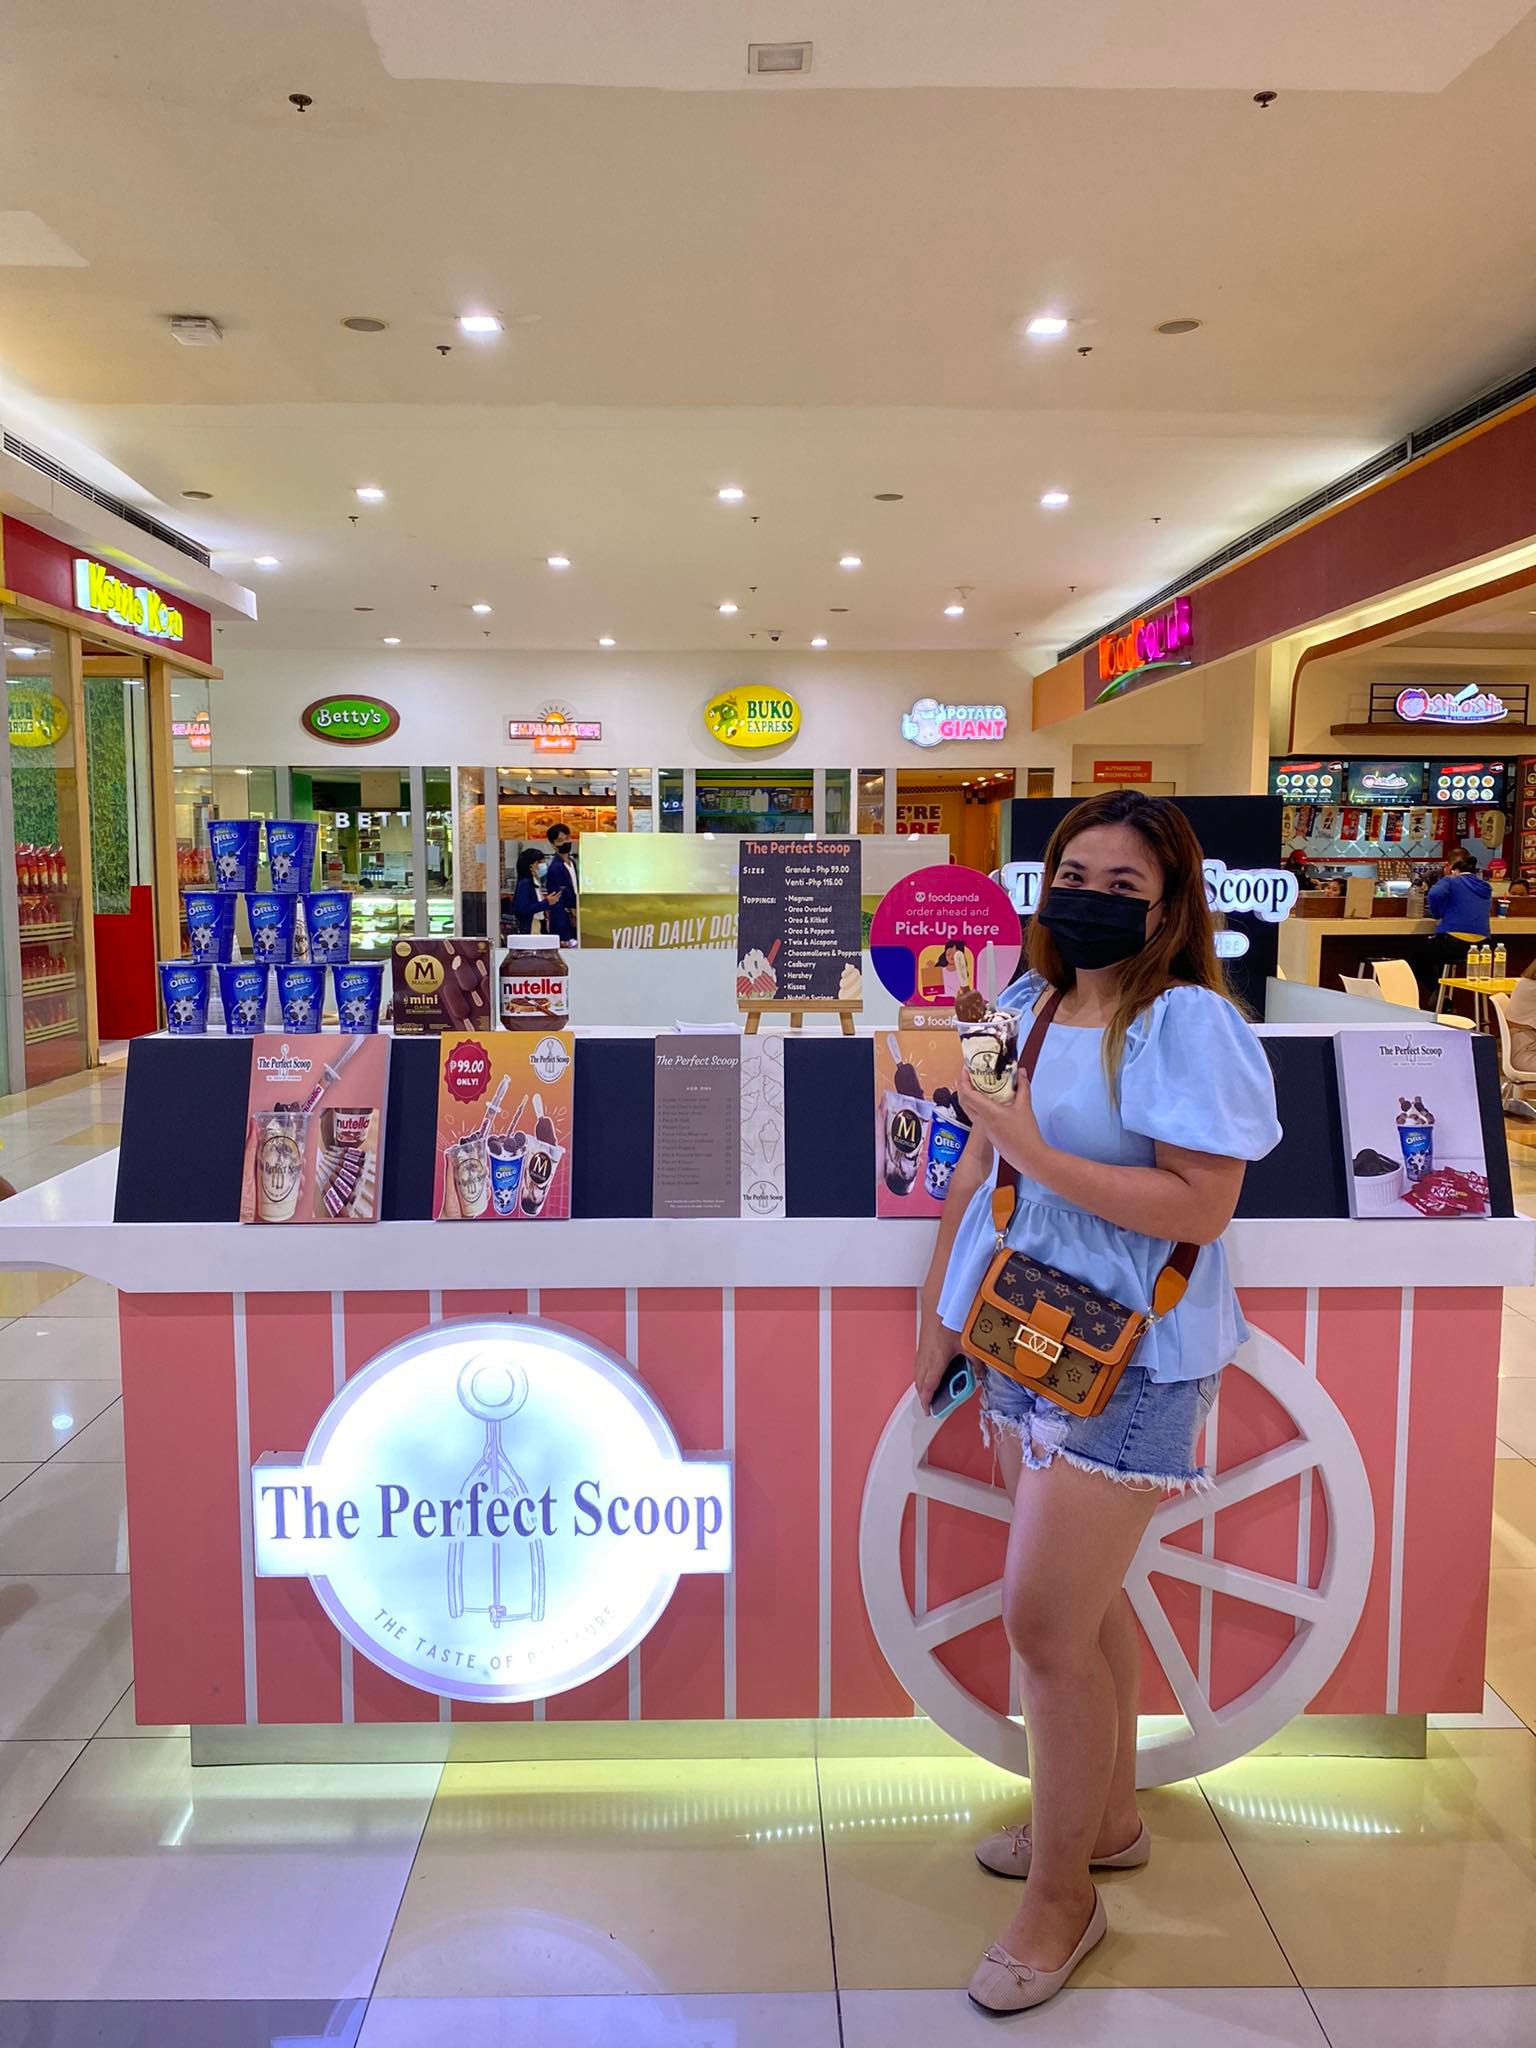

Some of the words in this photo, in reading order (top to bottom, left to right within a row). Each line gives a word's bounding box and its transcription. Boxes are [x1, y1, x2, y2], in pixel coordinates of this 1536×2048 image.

[746, 700, 794, 719] BUKO
[947, 707, 1005, 720] POTATO
[317, 708, 381, 727] Betty's
[747, 720, 794, 733] EXPRESS
[940, 721, 1005, 737] GIANT
[745, 841, 768, 854] The
[770, 841, 813, 854] Perfect
[816, 841, 851, 857] Scoop
[784, 865, 811, 874] Grande
[816, 865, 830, 875] Php
[830, 865, 850, 874] 99.00
[784, 878, 805, 886] Venti
[1203, 867, 1289, 912] Scoop
[787, 895, 814, 904] Magnum
[927, 893, 980, 904] foodpanda
[804, 905, 833, 913] Overload
[905, 907, 934, 917] order
[937, 907, 968, 917] ahead
[969, 907, 989, 917] and
[612, 924, 655, 949] YOUR
[658, 917, 707, 946] DAILY
[709, 913, 739, 940] DOS
[787, 927, 803, 935] Oreo
[895, 921, 958, 939] Pick-Up
[962, 921, 1000, 936] here
[414, 961, 435, 980] M
[787, 971, 813, 980] Hershey
[503, 978, 562, 995] nutella
[409, 994, 438, 1005] mini
[1379, 1045, 1394, 1055] The
[1395, 1045, 1420, 1056] Perfect
[1421, 1045, 1443, 1057] Scoop
[258, 1058, 270, 1068] The
[271, 1058, 292, 1068] Perfect
[293, 1058, 311, 1070] Scoop
[656, 1055, 673, 1066] The
[675, 1055, 709, 1069] Perfect
[711, 1055, 739, 1069] Scoop
[456, 1077, 479, 1086] ONLY!
[336, 1116, 370, 1130] nutella
[934, 1135, 961, 1150] OREO
[261, 1485, 361, 1540] The
[375, 1481, 558, 1540] Perfect
[572, 1479, 724, 1552] Scoop
[373, 1608, 408, 1641] THE
[415, 1637, 476, 1669] TASTE
[489, 1654, 513, 1670] OF
